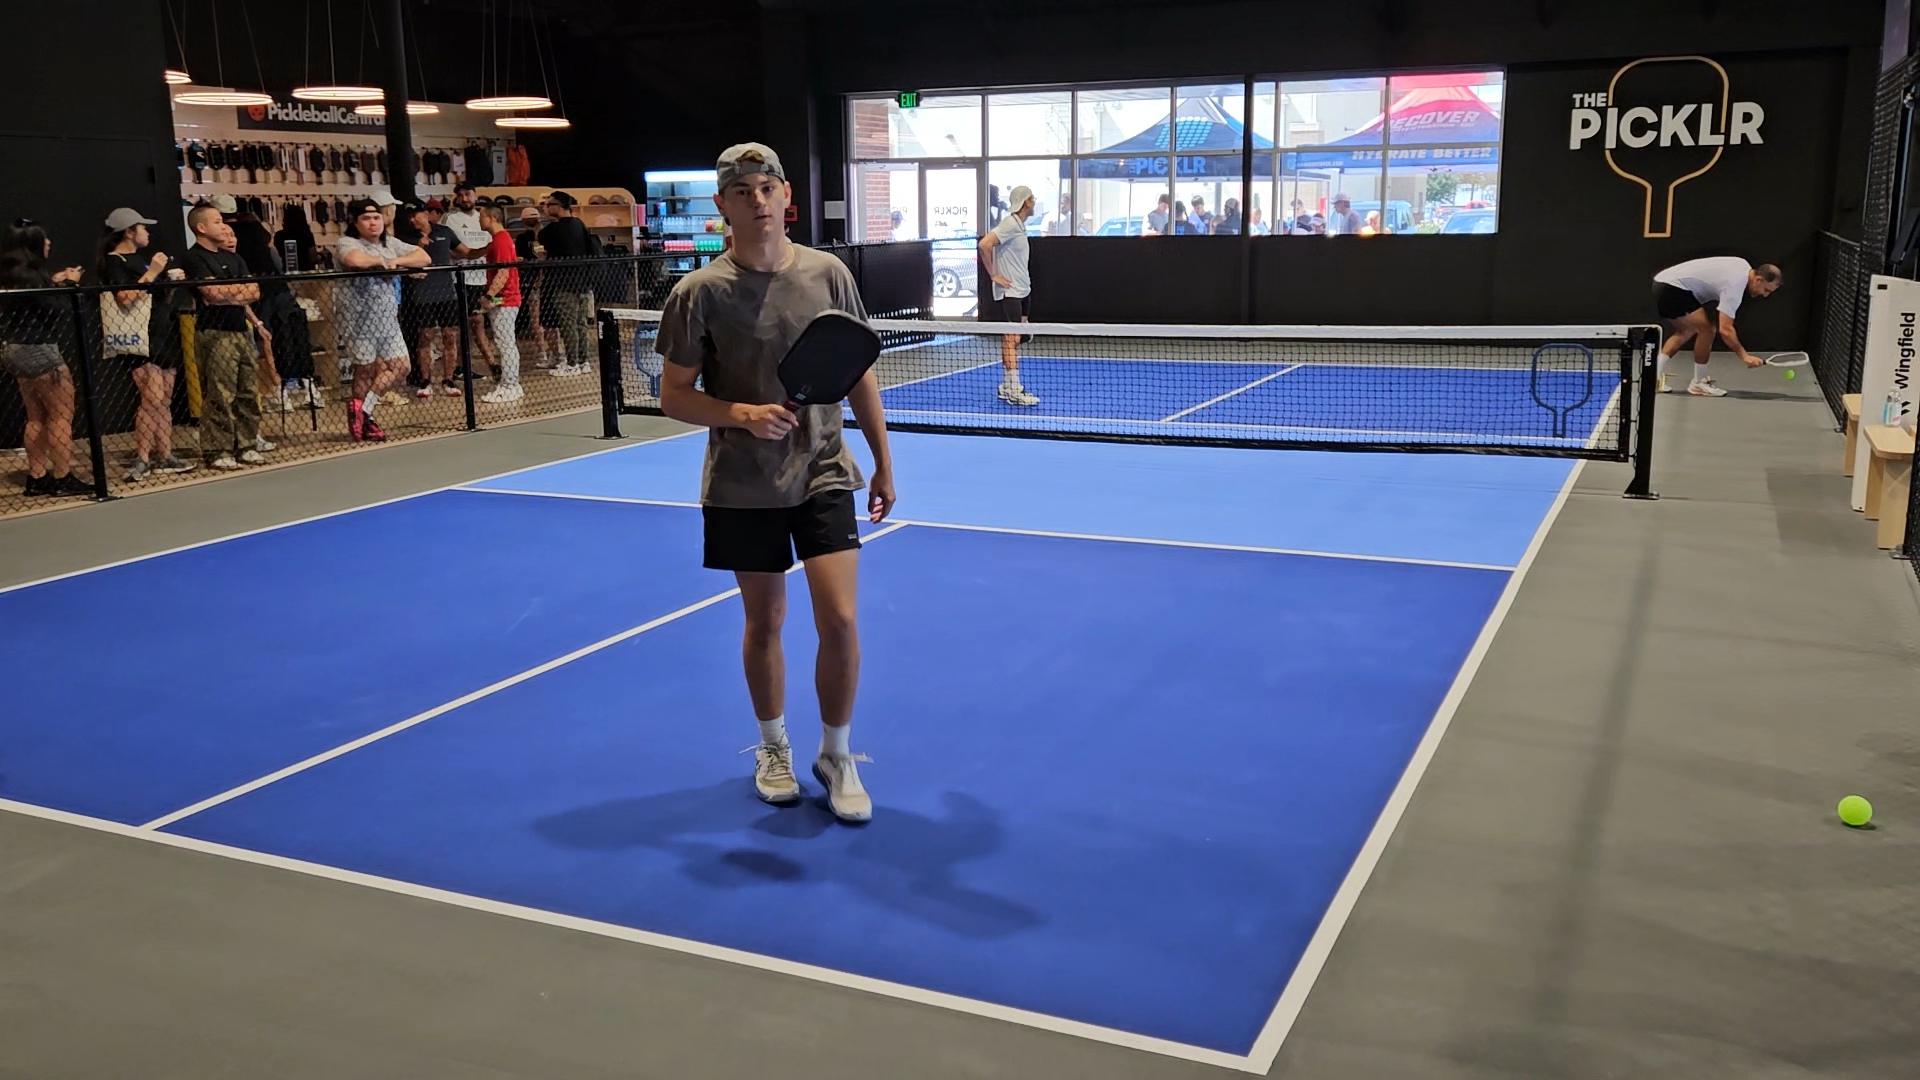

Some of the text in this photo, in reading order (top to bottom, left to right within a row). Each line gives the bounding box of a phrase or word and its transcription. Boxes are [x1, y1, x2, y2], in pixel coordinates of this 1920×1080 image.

[901, 93, 917, 107] EXIT
[1572, 92, 1608, 108] THE
[1569, 101, 1765, 150] PICKLR
[1433, 147, 1492, 158] BETTER
[1894, 312, 1916, 389] Wingfield
